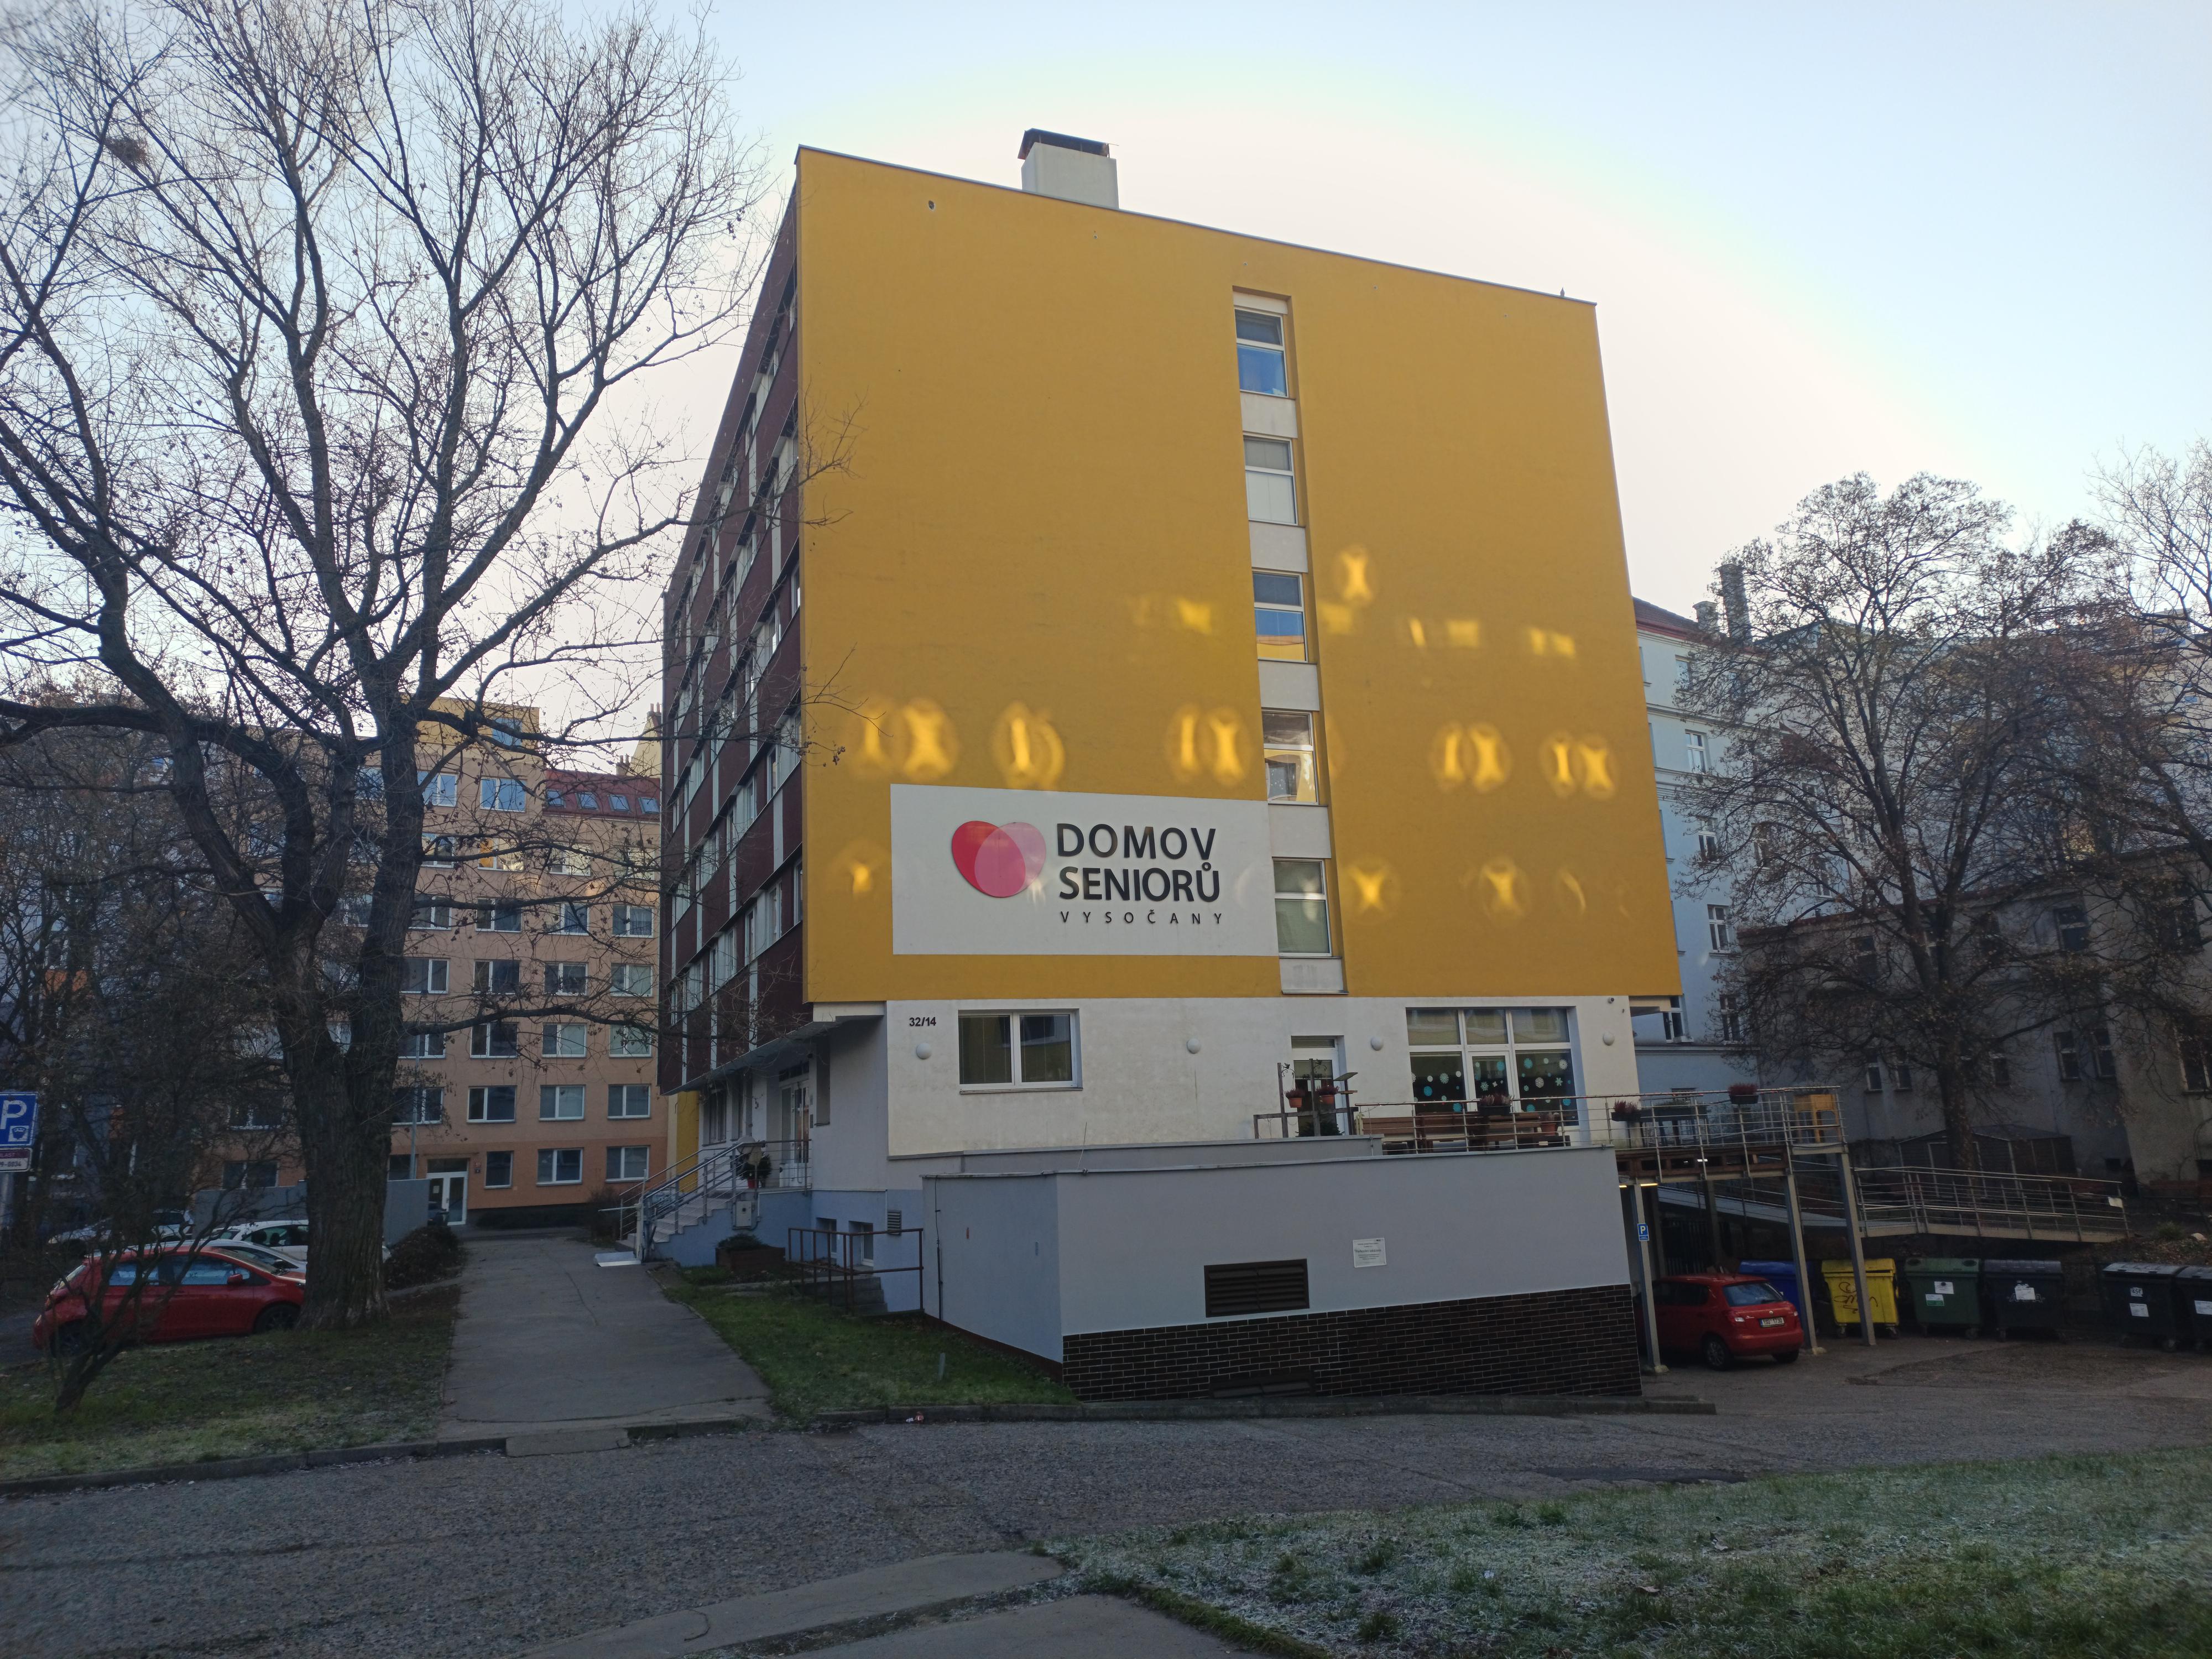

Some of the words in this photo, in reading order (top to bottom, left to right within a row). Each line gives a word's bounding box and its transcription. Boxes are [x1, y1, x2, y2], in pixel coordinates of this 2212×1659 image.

[1057, 823, 1216, 860] DOMOV
[1058, 862, 1220, 902] SENIORŮ
[1060, 909, 1222, 925] VYSOČANY
[909, 1016, 937, 1027] 32/14
[0, 1100, 27, 1130] P
[1640, 1225, 1646, 1234] P
